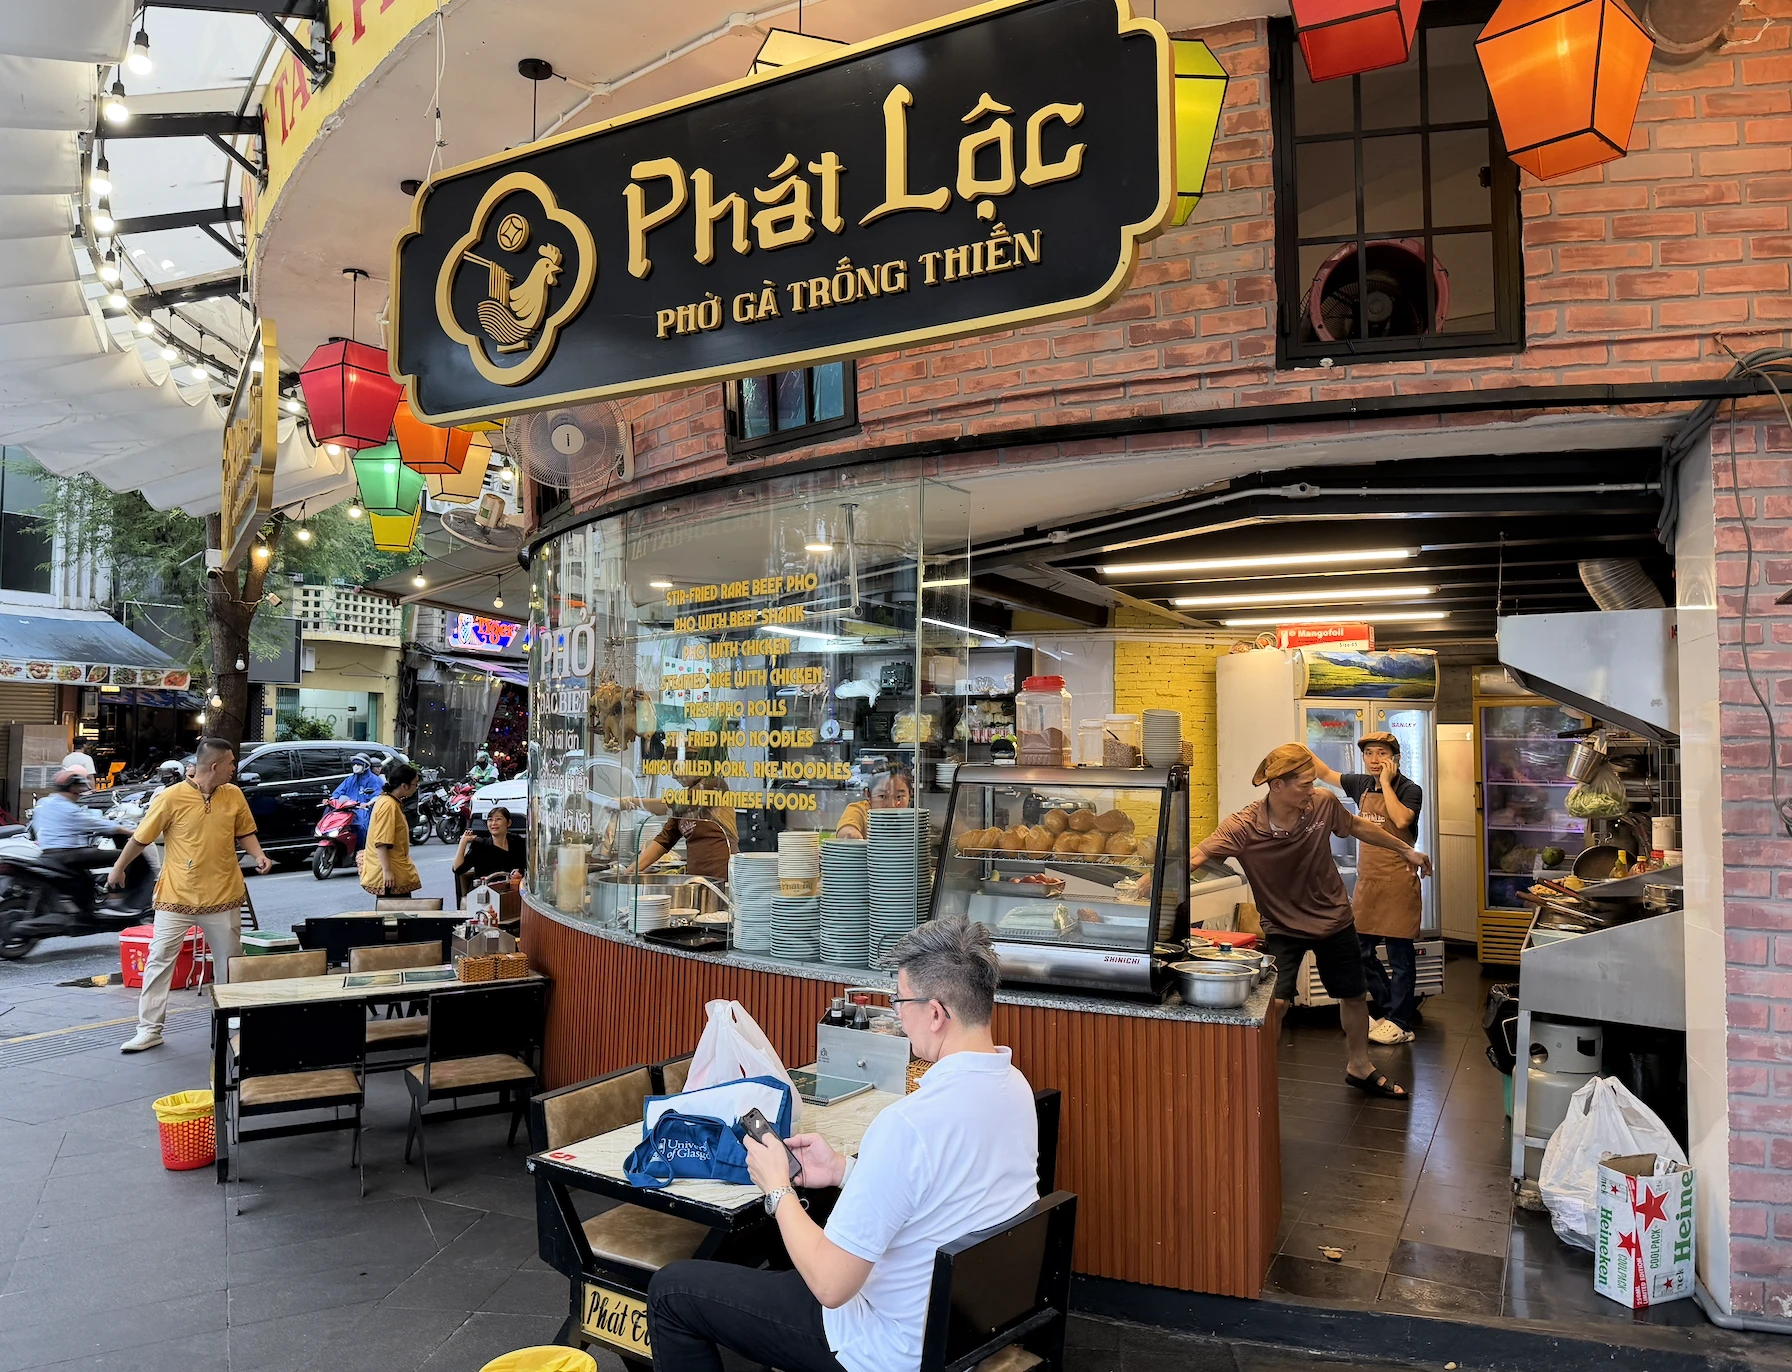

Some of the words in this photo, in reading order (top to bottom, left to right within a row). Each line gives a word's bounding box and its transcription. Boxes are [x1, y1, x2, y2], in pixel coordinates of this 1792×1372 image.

[622, 151, 848, 280] Phát
[857, 83, 1088, 228] Lộc
[733, 279, 782, 324] GÀ
[786, 255, 909, 313] TRỐNG
[918, 221, 1043, 286] THIẾN
[666, 585, 718, 606] STIR-FRIED
[721, 580, 750, 599] RARE
[752, 576, 783, 596] BEEF
[787, 572, 818, 591] PHO
[475, 616, 518, 645] Tiger
[674, 617, 697, 633] PHO
[698, 612, 728, 631] WITH
[729, 609, 760, 628] BEEF
[761, 605, 806, 624] SHANK
[540, 607, 597, 681] PHỞ
[1297, 628, 1345, 639] Mangofoil
[683, 643, 707, 661] PHO
[708, 641, 739, 659] WITH
[741, 637, 791, 656] CHICKEN
[661, 672, 708, 691] STEAMED
[709, 671, 732, 688] RICE
[734, 669, 768, 688] WITH
[769, 666, 823, 685] CHICKEN
[683, 701, 718, 718] FRESH
[718, 700, 745, 718] PHO
[747, 699, 788, 718] ROLLS
[665, 730, 718, 748] STIR-FRIED
[719, 729, 746, 747] PHO
[749, 729, 815, 748] NOODLES
[642, 759, 672, 776] HANOI
[672, 760, 712, 777] GRILLED
[714, 760, 750, 779] PORK,
[753, 761, 780, 778] RICE
[782, 761, 851, 780] NOODLES
[661, 787, 690, 806] LOCAL
[691, 789, 763, 810] VIETNAMESE
[766, 792, 817, 811] FOODS
[1103, 955, 1140, 965] SHINICHI
[666, 1147, 679, 1161] of
[677, 1148, 712, 1161] Glasgo
[1599, 1207, 1613, 1287] Heineken
[1650, 1228, 1661, 1269] COOLPACK
[1617, 1253, 1628, 1291] COOLPACK
[1636, 1257, 1646, 1281] EDITION
[586, 1290, 629, 1337] Phát
